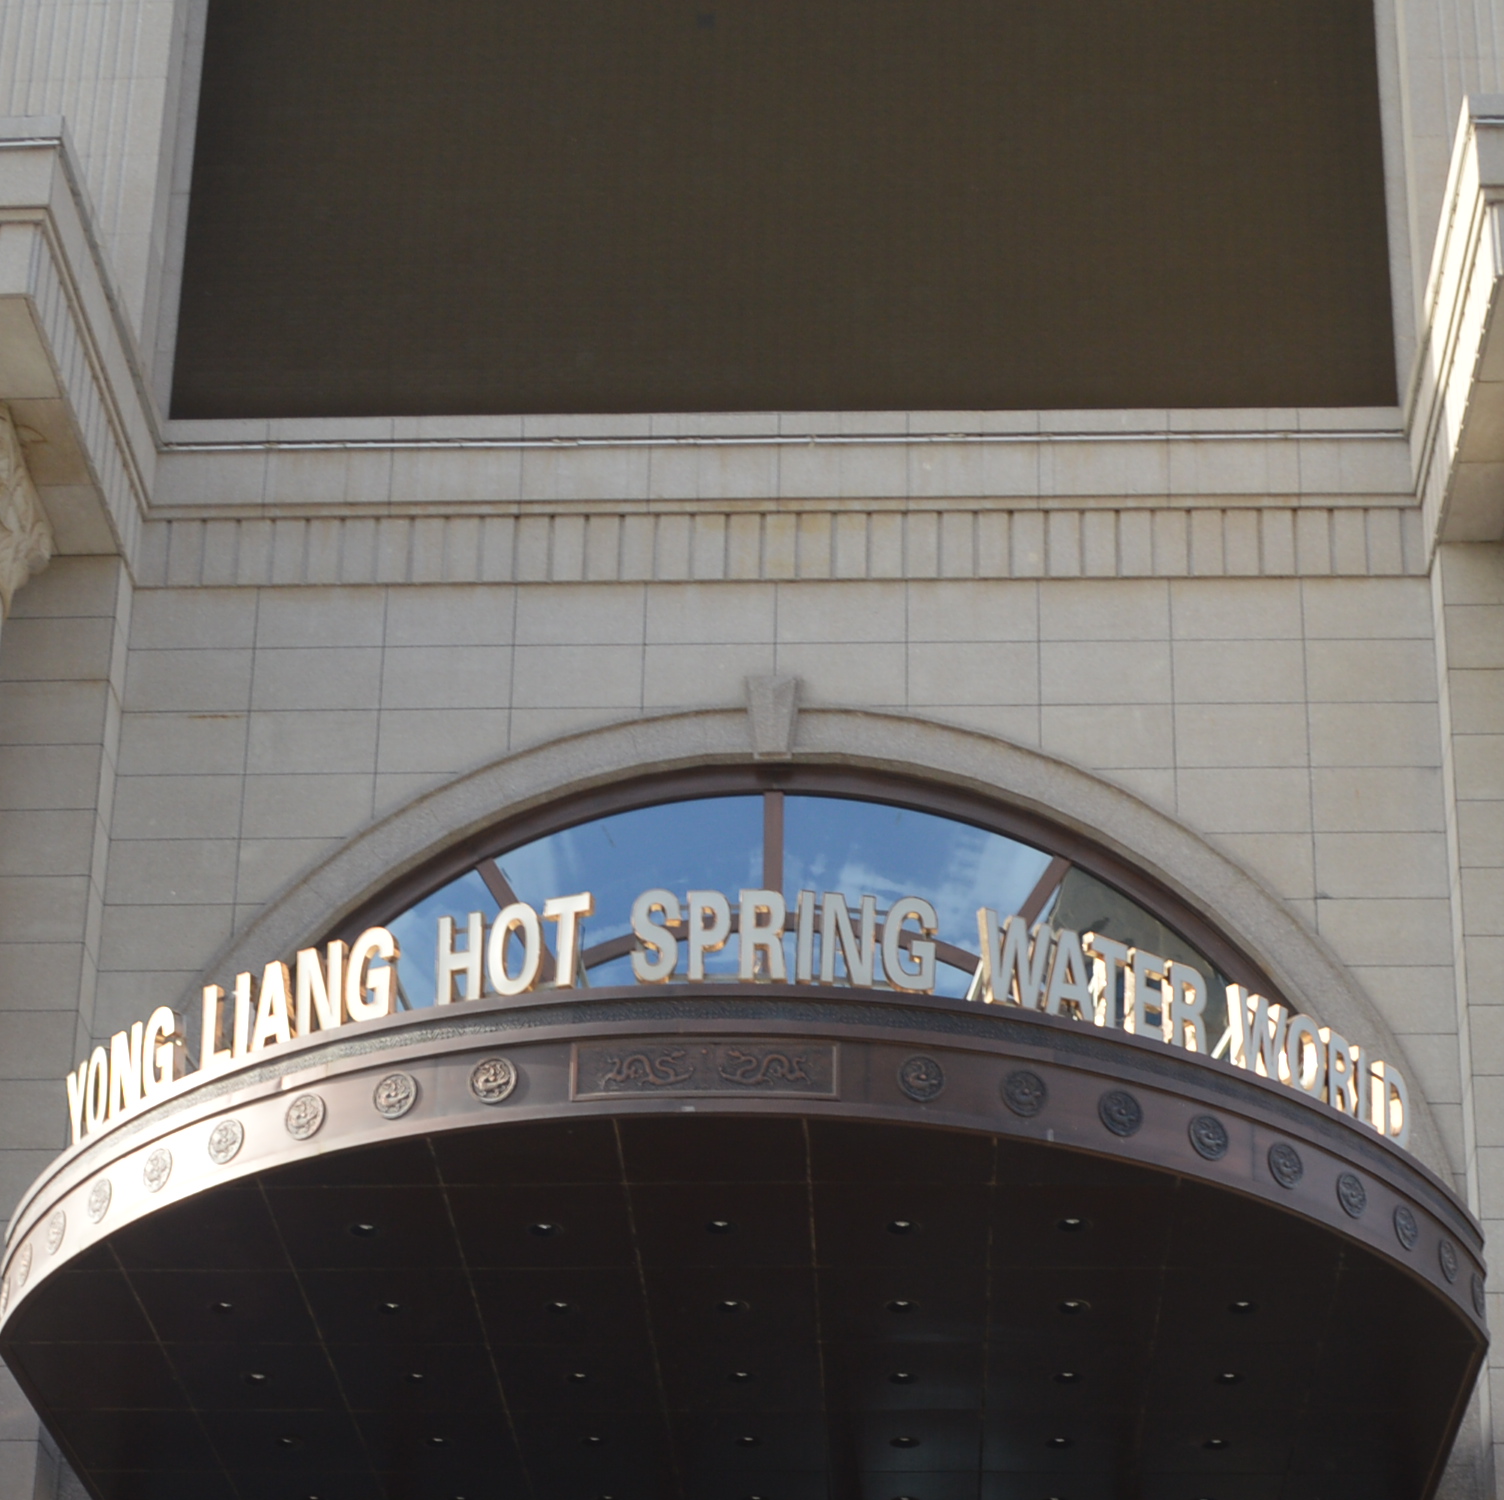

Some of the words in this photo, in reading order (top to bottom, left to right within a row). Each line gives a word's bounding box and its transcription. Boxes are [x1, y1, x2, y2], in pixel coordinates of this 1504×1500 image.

[66, 1005, 184, 1145] YONG
[199, 926, 399, 1070] LIANG
[436, 892, 594, 1006] HOT
[629, 888, 939, 994] SPRING
[976, 907, 1208, 1054] WATER
[1225, 982, 1410, 1149] WORLD
